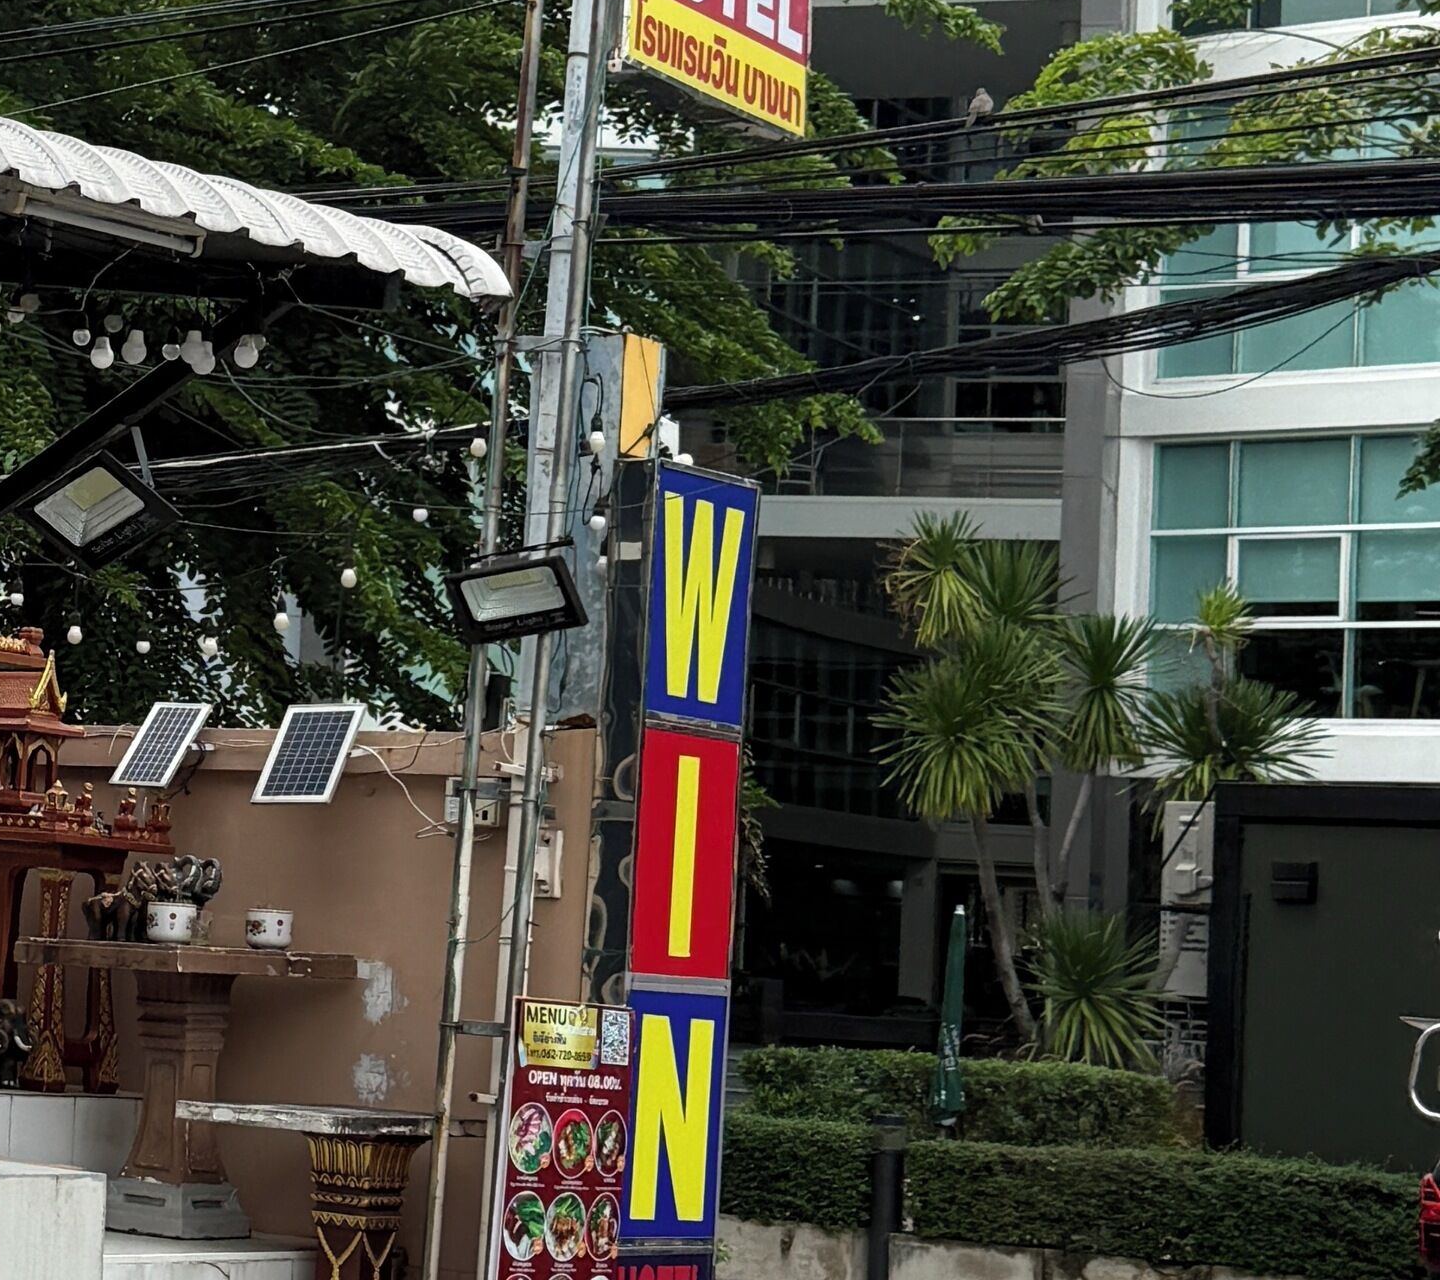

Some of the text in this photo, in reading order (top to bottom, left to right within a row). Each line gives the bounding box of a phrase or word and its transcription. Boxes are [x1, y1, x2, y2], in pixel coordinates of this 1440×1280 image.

[744, 64, 801, 126] บางนา
[526, 1005, 567, 1026] MENU
[528, 1070, 557, 1085] OPEN
